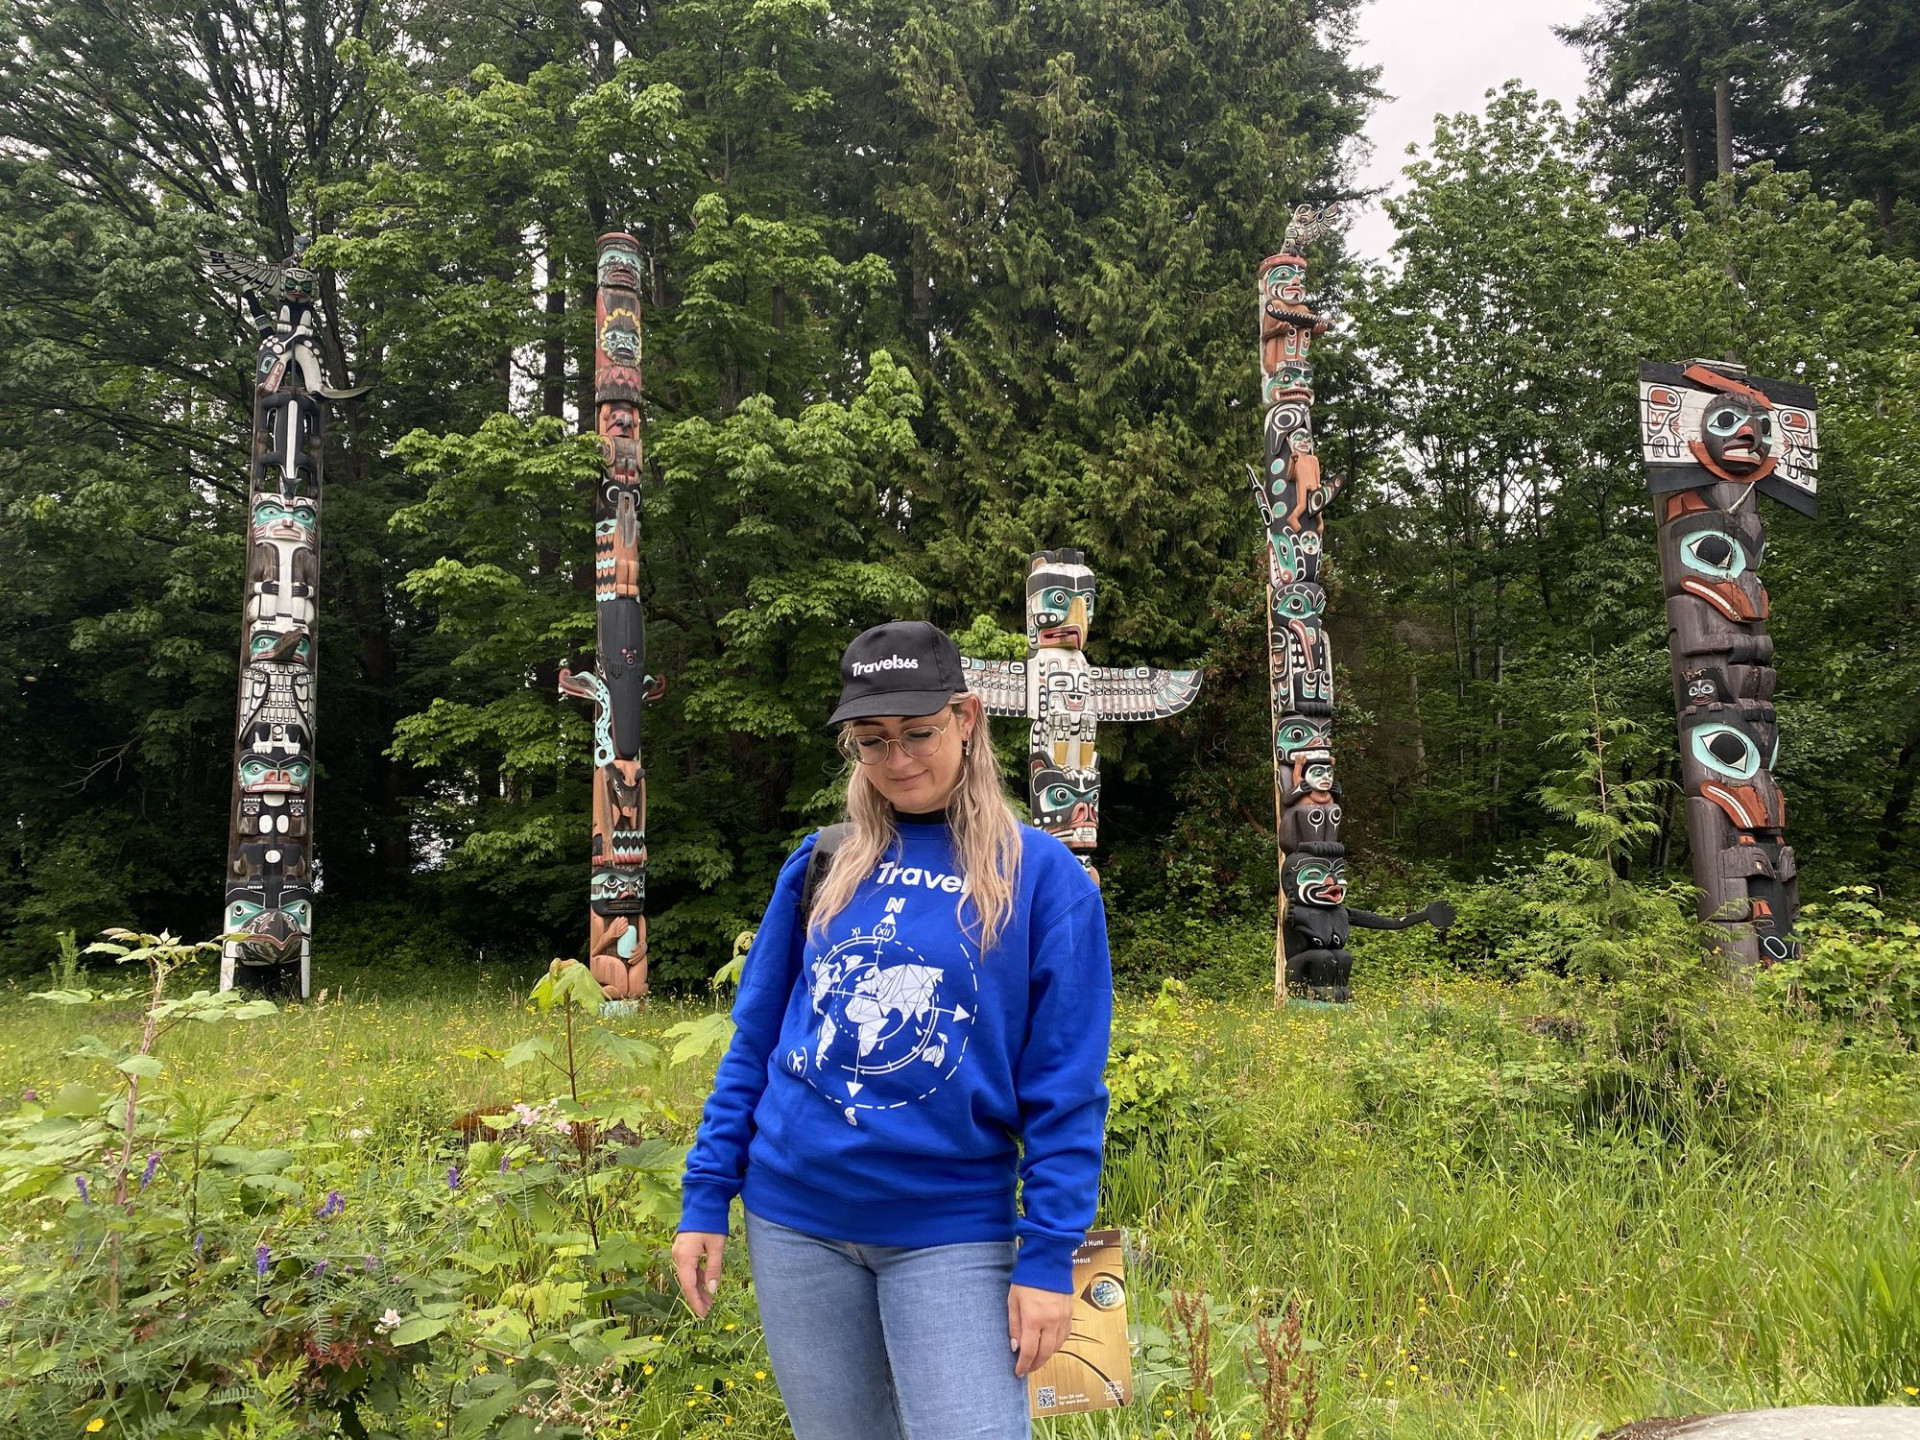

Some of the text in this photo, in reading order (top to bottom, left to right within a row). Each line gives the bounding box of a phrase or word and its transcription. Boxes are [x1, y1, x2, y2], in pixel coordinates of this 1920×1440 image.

[851, 654, 919, 677] Travel365
[884, 897, 907, 914] N
[844, 1106, 858, 1127] S
[1088, 1239, 1104, 1247] Hunt
